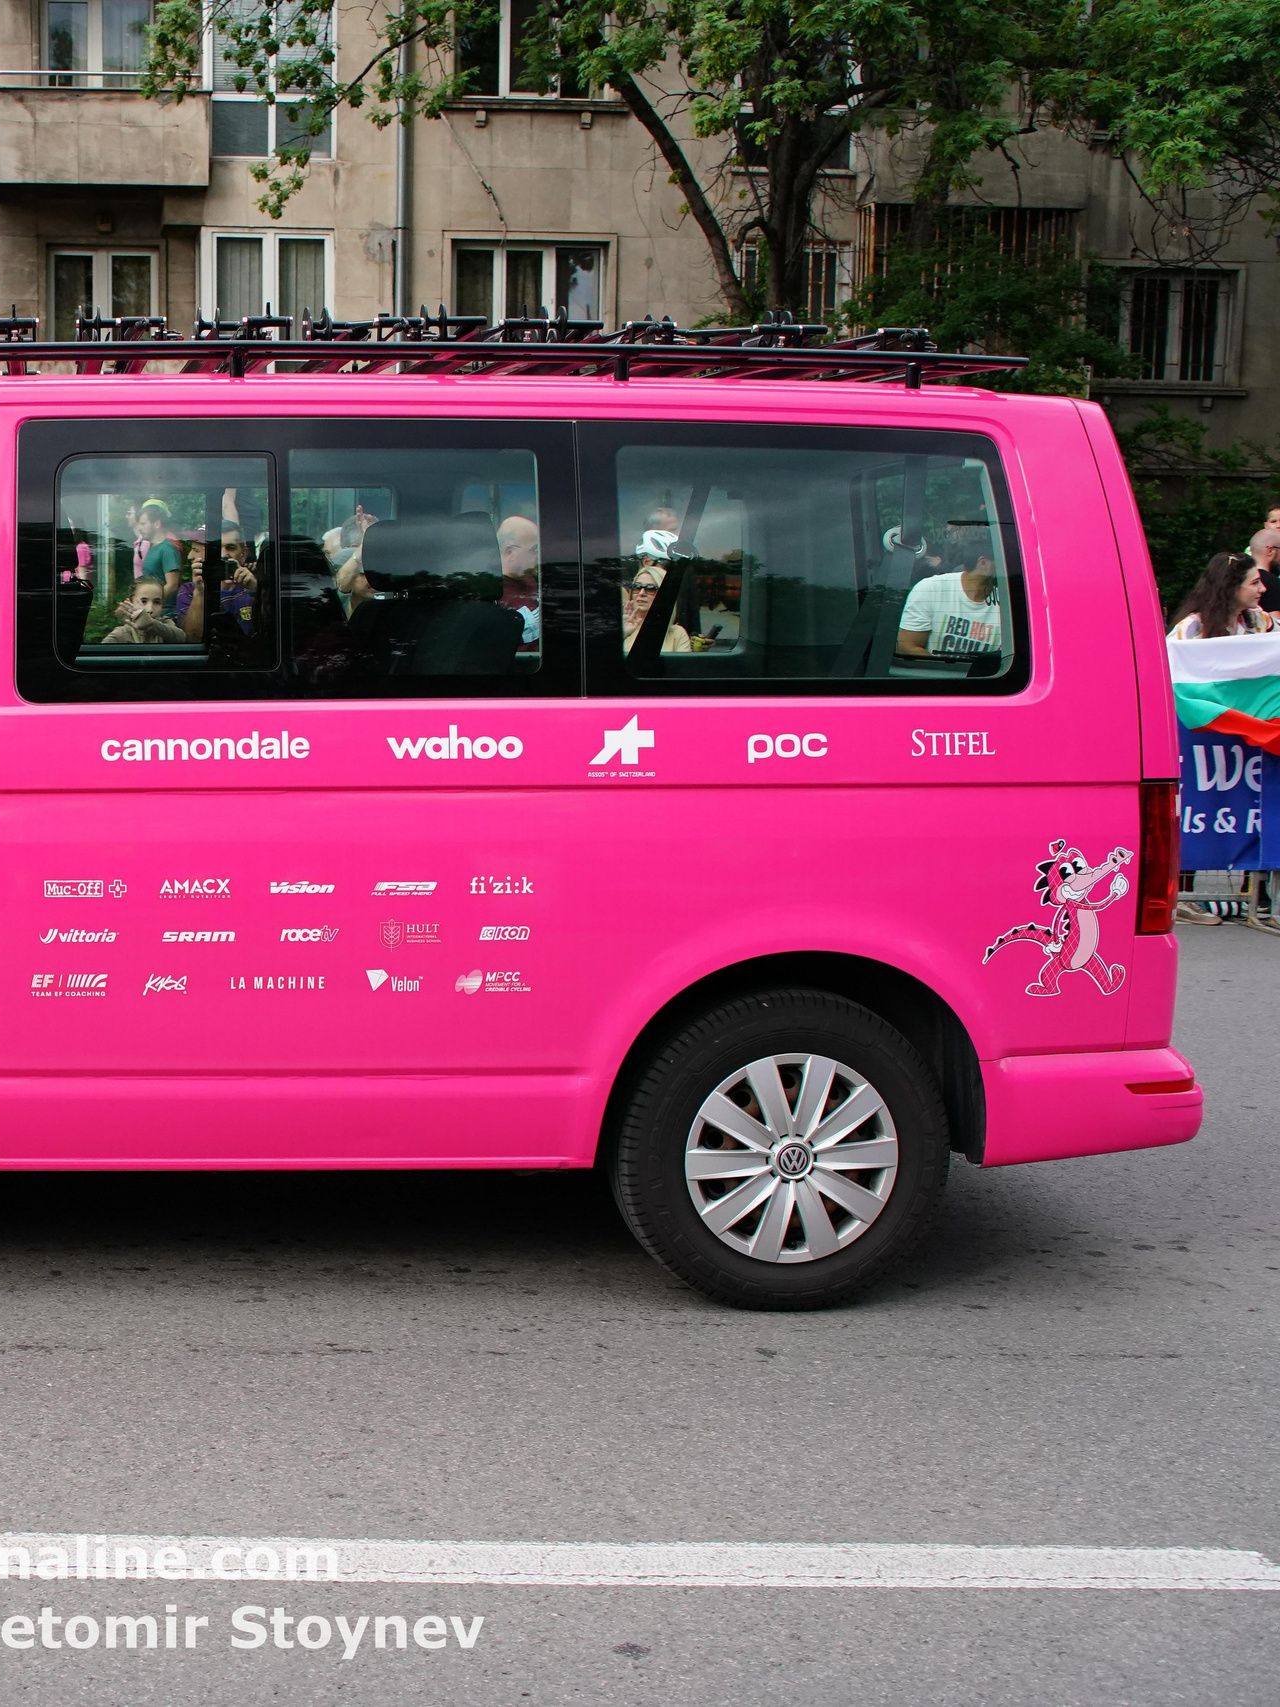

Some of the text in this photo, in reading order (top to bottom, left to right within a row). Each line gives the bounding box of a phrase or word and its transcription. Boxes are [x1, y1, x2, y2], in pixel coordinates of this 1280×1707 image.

[945, 615, 994, 643] RED HOT
[100, 730, 311, 762] cannondale
[386, 724, 524, 760] wahoo
[747, 732, 829, 764] poc
[911, 728, 997, 757] STIFEL
[1213, 807, 1237, 834] &
[47, 883, 101, 896] Muc-Off
[159, 878, 231, 894] AMACX
[269, 880, 336, 894] Vision
[58, 928, 120, 943] vittoria
[406, 923, 440, 933] HULT
[161, 930, 236, 943] SRAM
[30, 973, 55, 989] EF
[230, 976, 326, 990] LA MACHINE
[485, 971, 521, 982] MPCC
